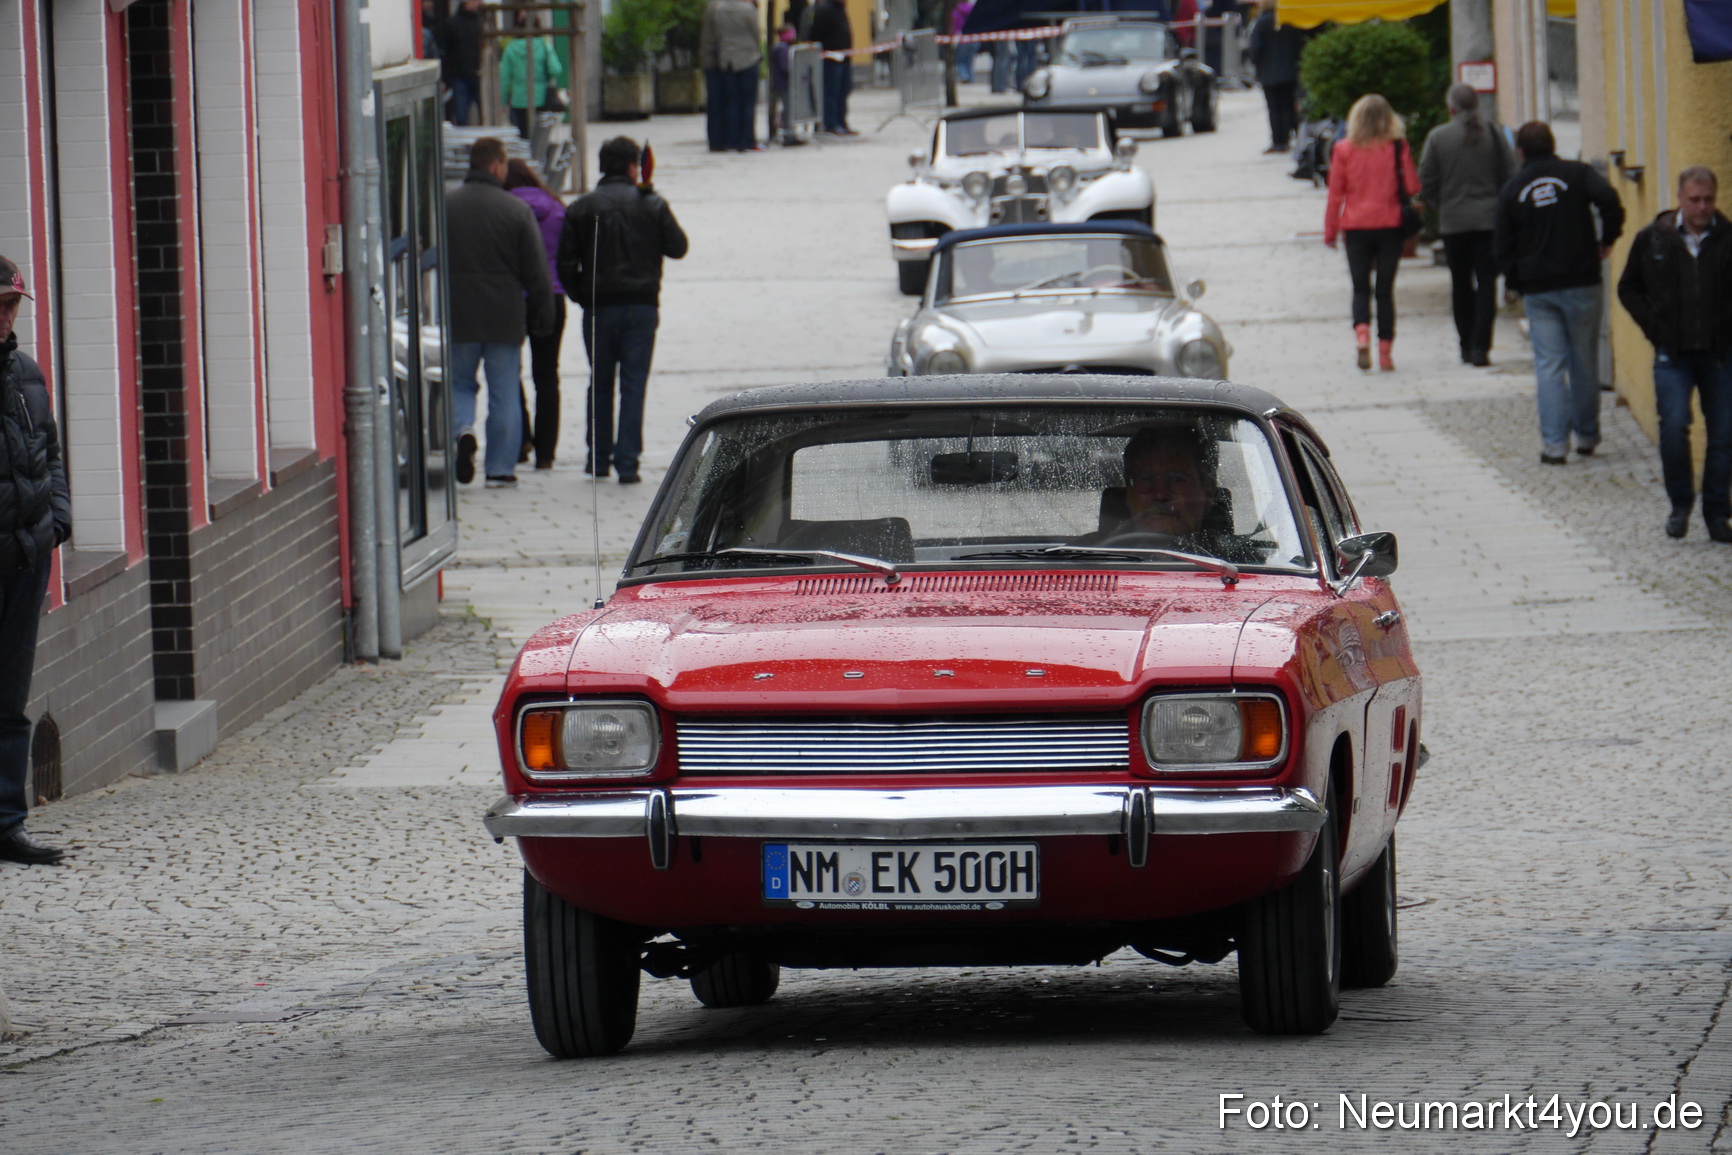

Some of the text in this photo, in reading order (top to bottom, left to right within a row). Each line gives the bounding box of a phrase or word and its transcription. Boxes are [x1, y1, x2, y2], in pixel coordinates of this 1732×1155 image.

[790, 851, 1034, 893] NM EK 500H
[773, 877, 781, 890] D
[819, 901, 860, 910] Automobile
[861, 900, 889, 910] KÖLBL
